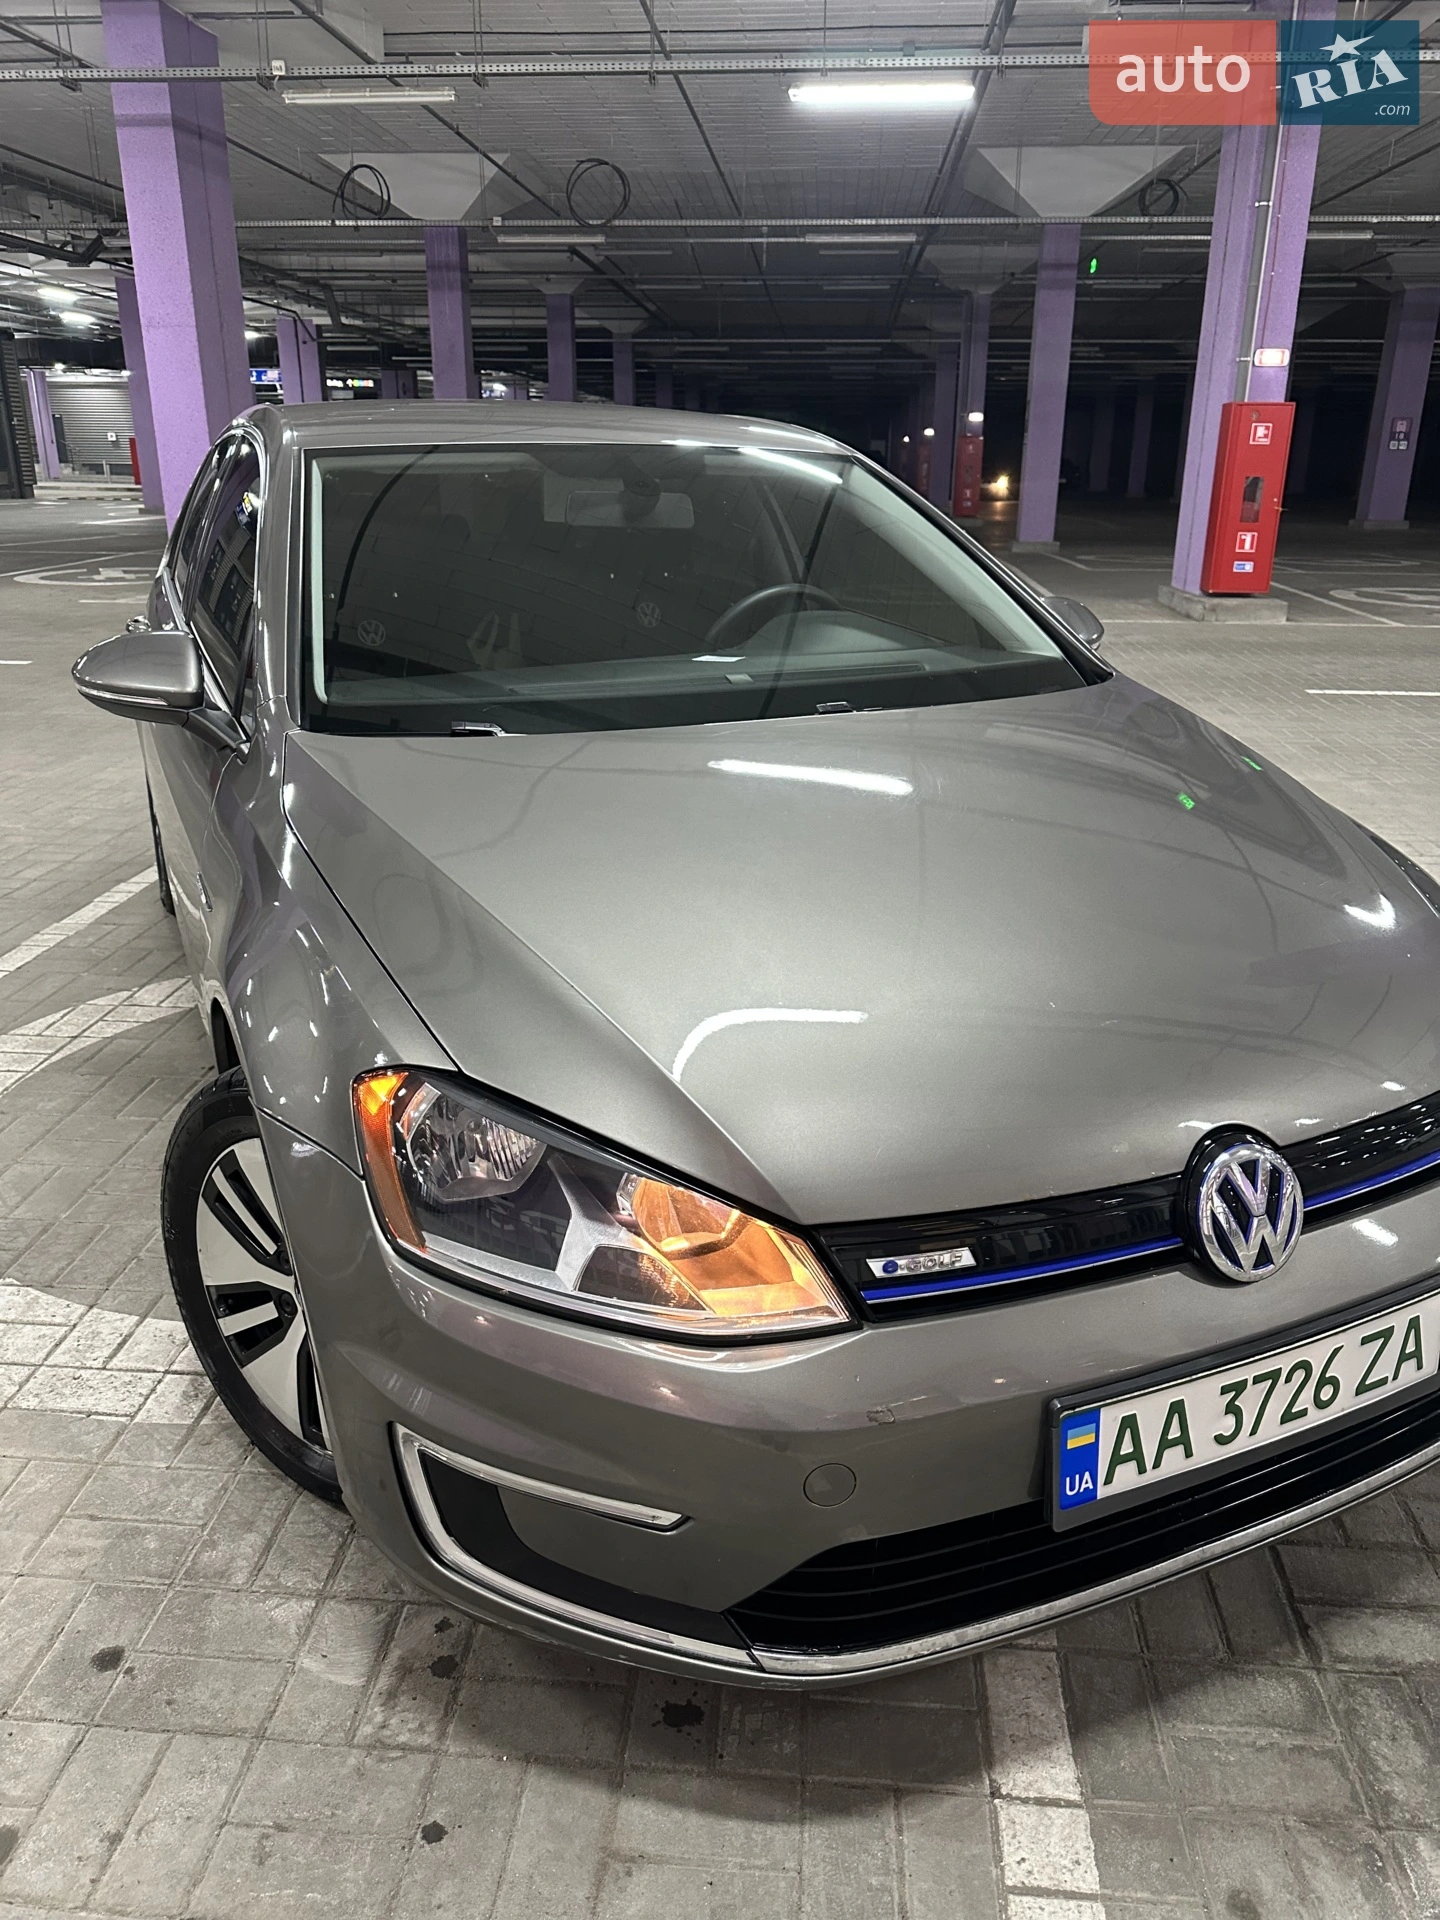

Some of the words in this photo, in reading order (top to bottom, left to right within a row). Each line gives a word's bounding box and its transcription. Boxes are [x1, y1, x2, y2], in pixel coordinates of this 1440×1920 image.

[1103, 1398, 1194, 1486] AA
[1213, 1345, 1345, 1446] 3726
[1354, 1314, 1425, 1397] ZA
[1065, 1471, 1094, 1496] UA
